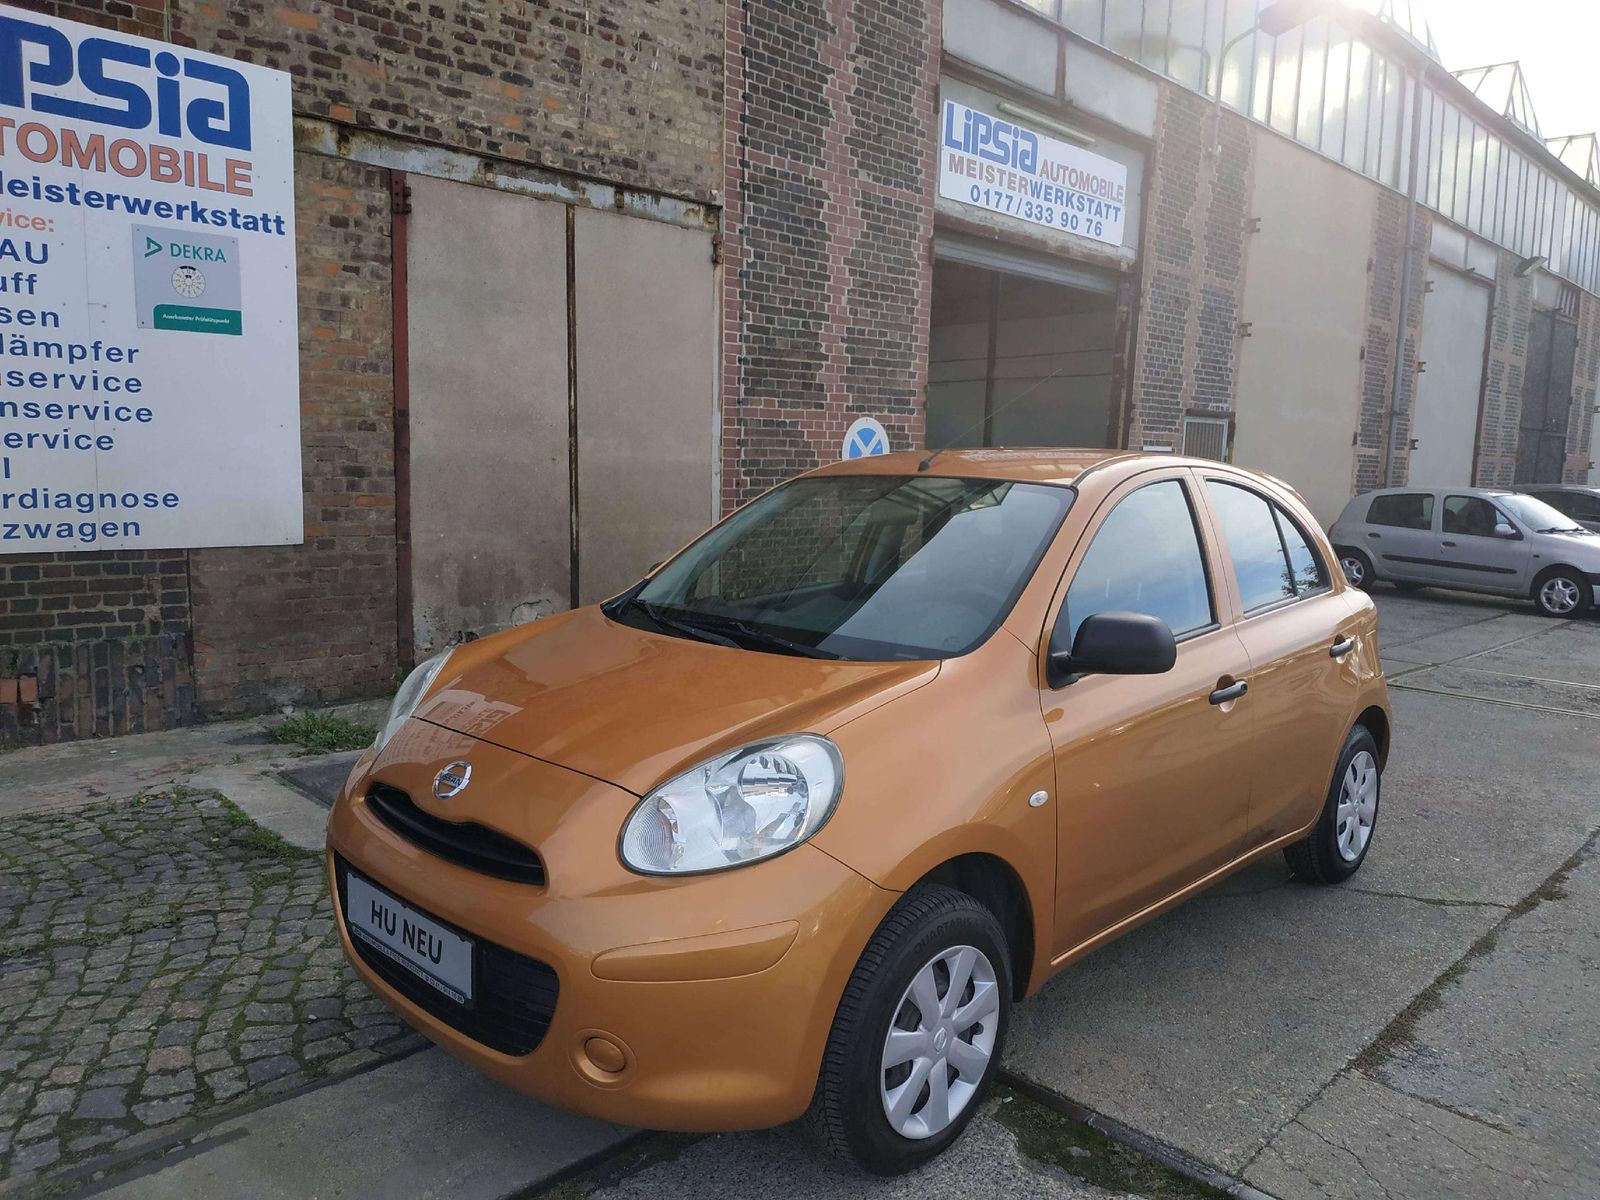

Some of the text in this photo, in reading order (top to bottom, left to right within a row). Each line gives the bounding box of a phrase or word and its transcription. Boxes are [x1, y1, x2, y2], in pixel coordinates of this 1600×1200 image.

[948, 153, 1121, 223] MEISTERWERKSTATT
[1039, 159, 1125, 202] AUTOMOBILE
[0, 170, 286, 236] eisterwerkstatt
[970, 184, 1103, 237] 0177/333 90 76
[170, 243, 227, 263] DEKRA
[0, 333, 139, 364] ämpfer
[0, 370, 142, 393] service
[0, 401, 153, 422] nservice
[0, 428, 114, 450] ervice
[2, 488, 180, 513] rdiagnose
[3, 520, 141, 543] zwagen
[371, 900, 397, 937] HU
[402, 919, 443, 965] NEU
